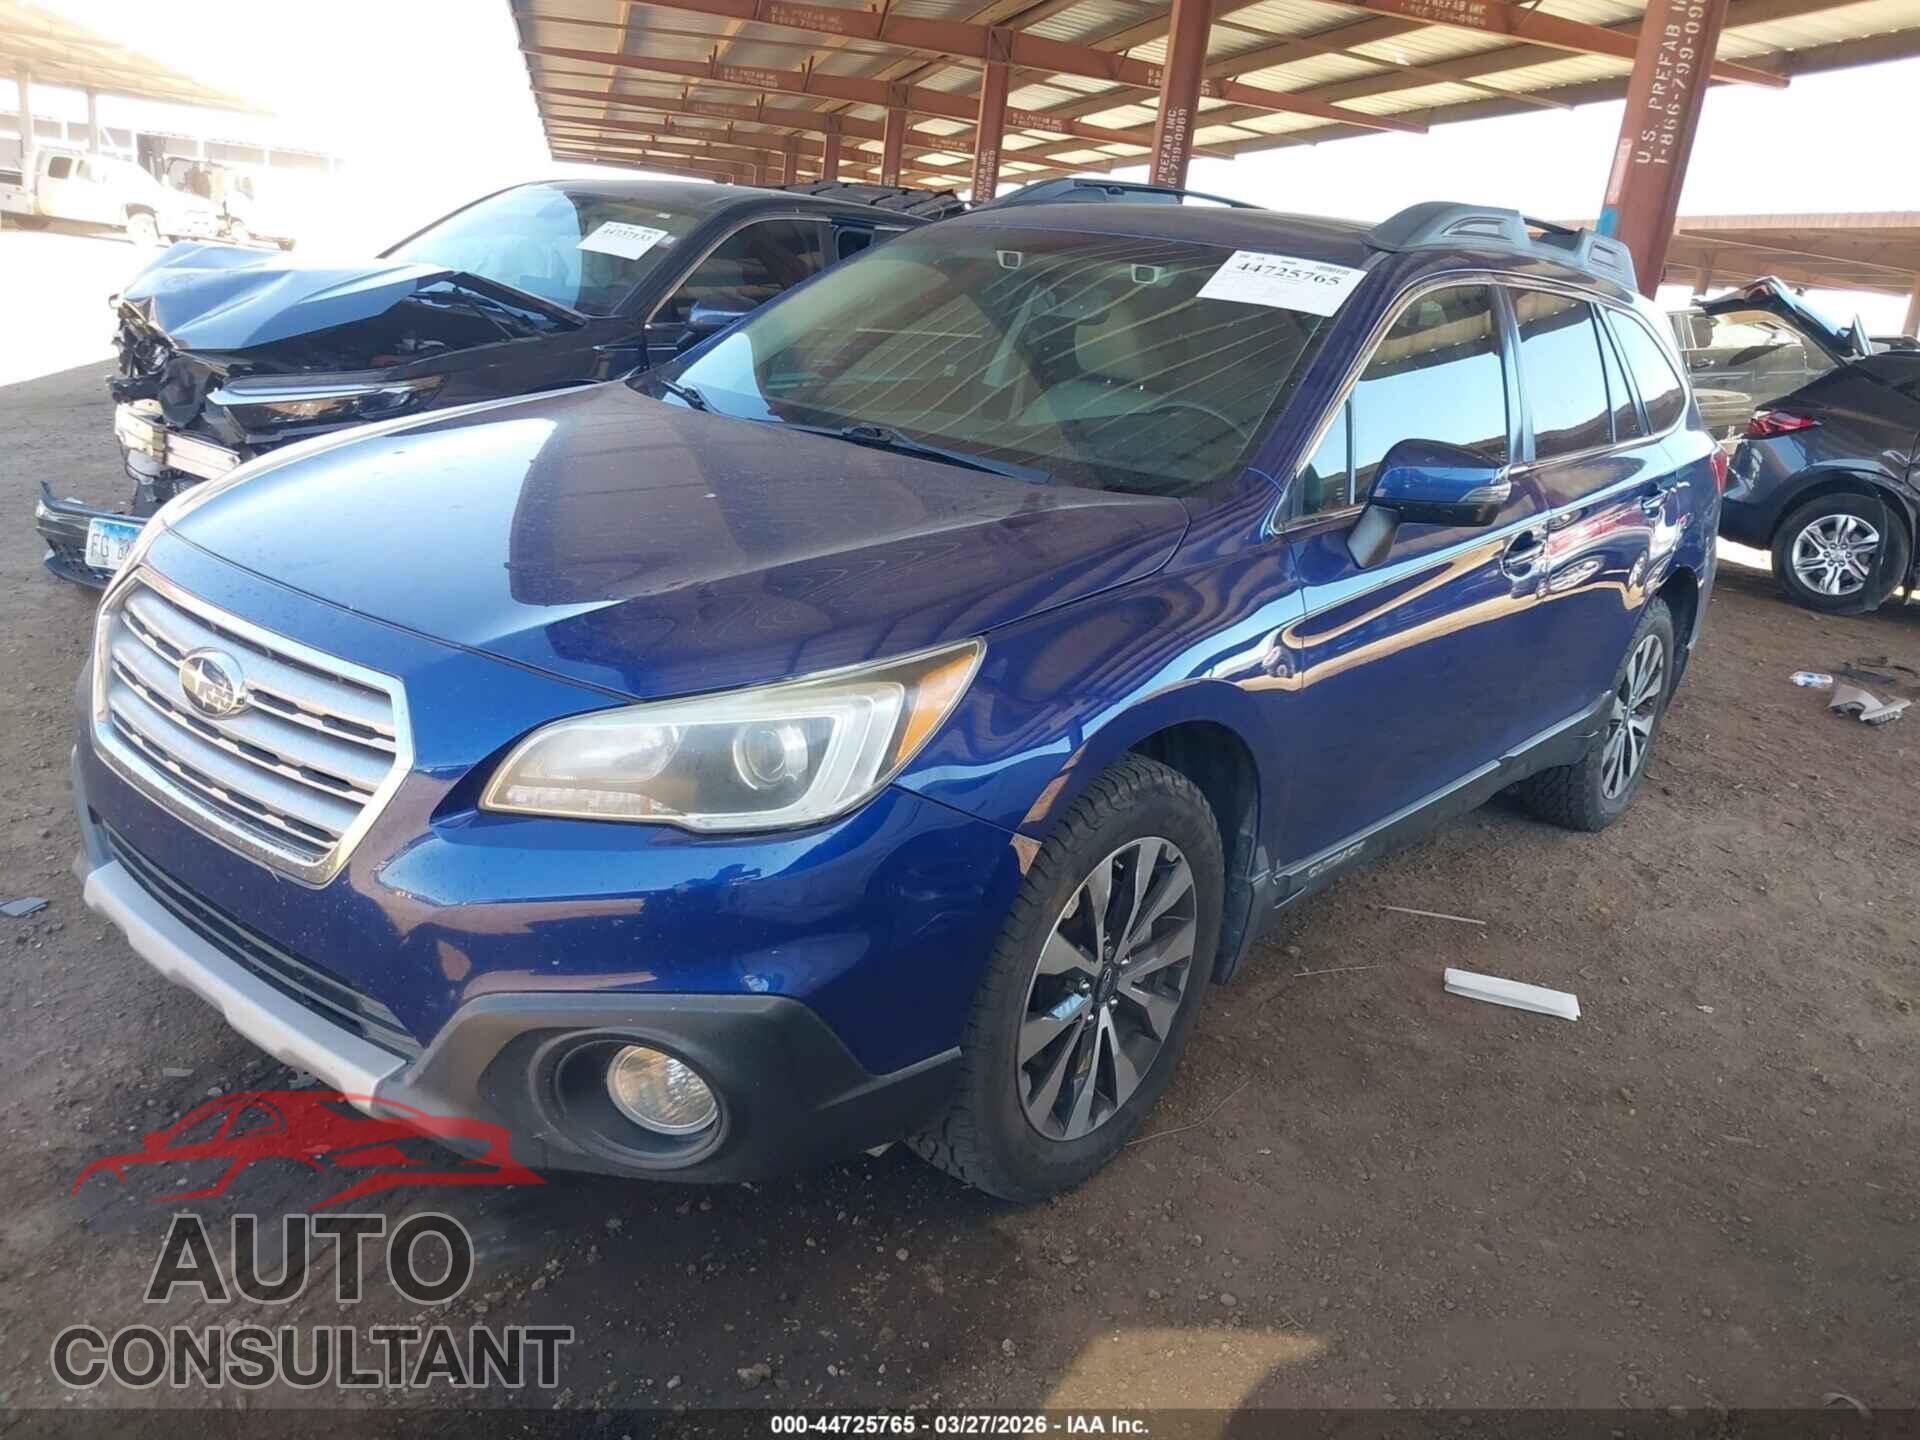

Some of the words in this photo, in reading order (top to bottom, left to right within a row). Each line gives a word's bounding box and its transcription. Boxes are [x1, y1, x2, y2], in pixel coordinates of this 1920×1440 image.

[1648, 25, 1681, 110] PREFAB
[1654, 0, 1706, 164] 1-866-799-09
[1157, 135, 1174, 182] PREFAB
[1236, 262, 1342, 286] 44725765
